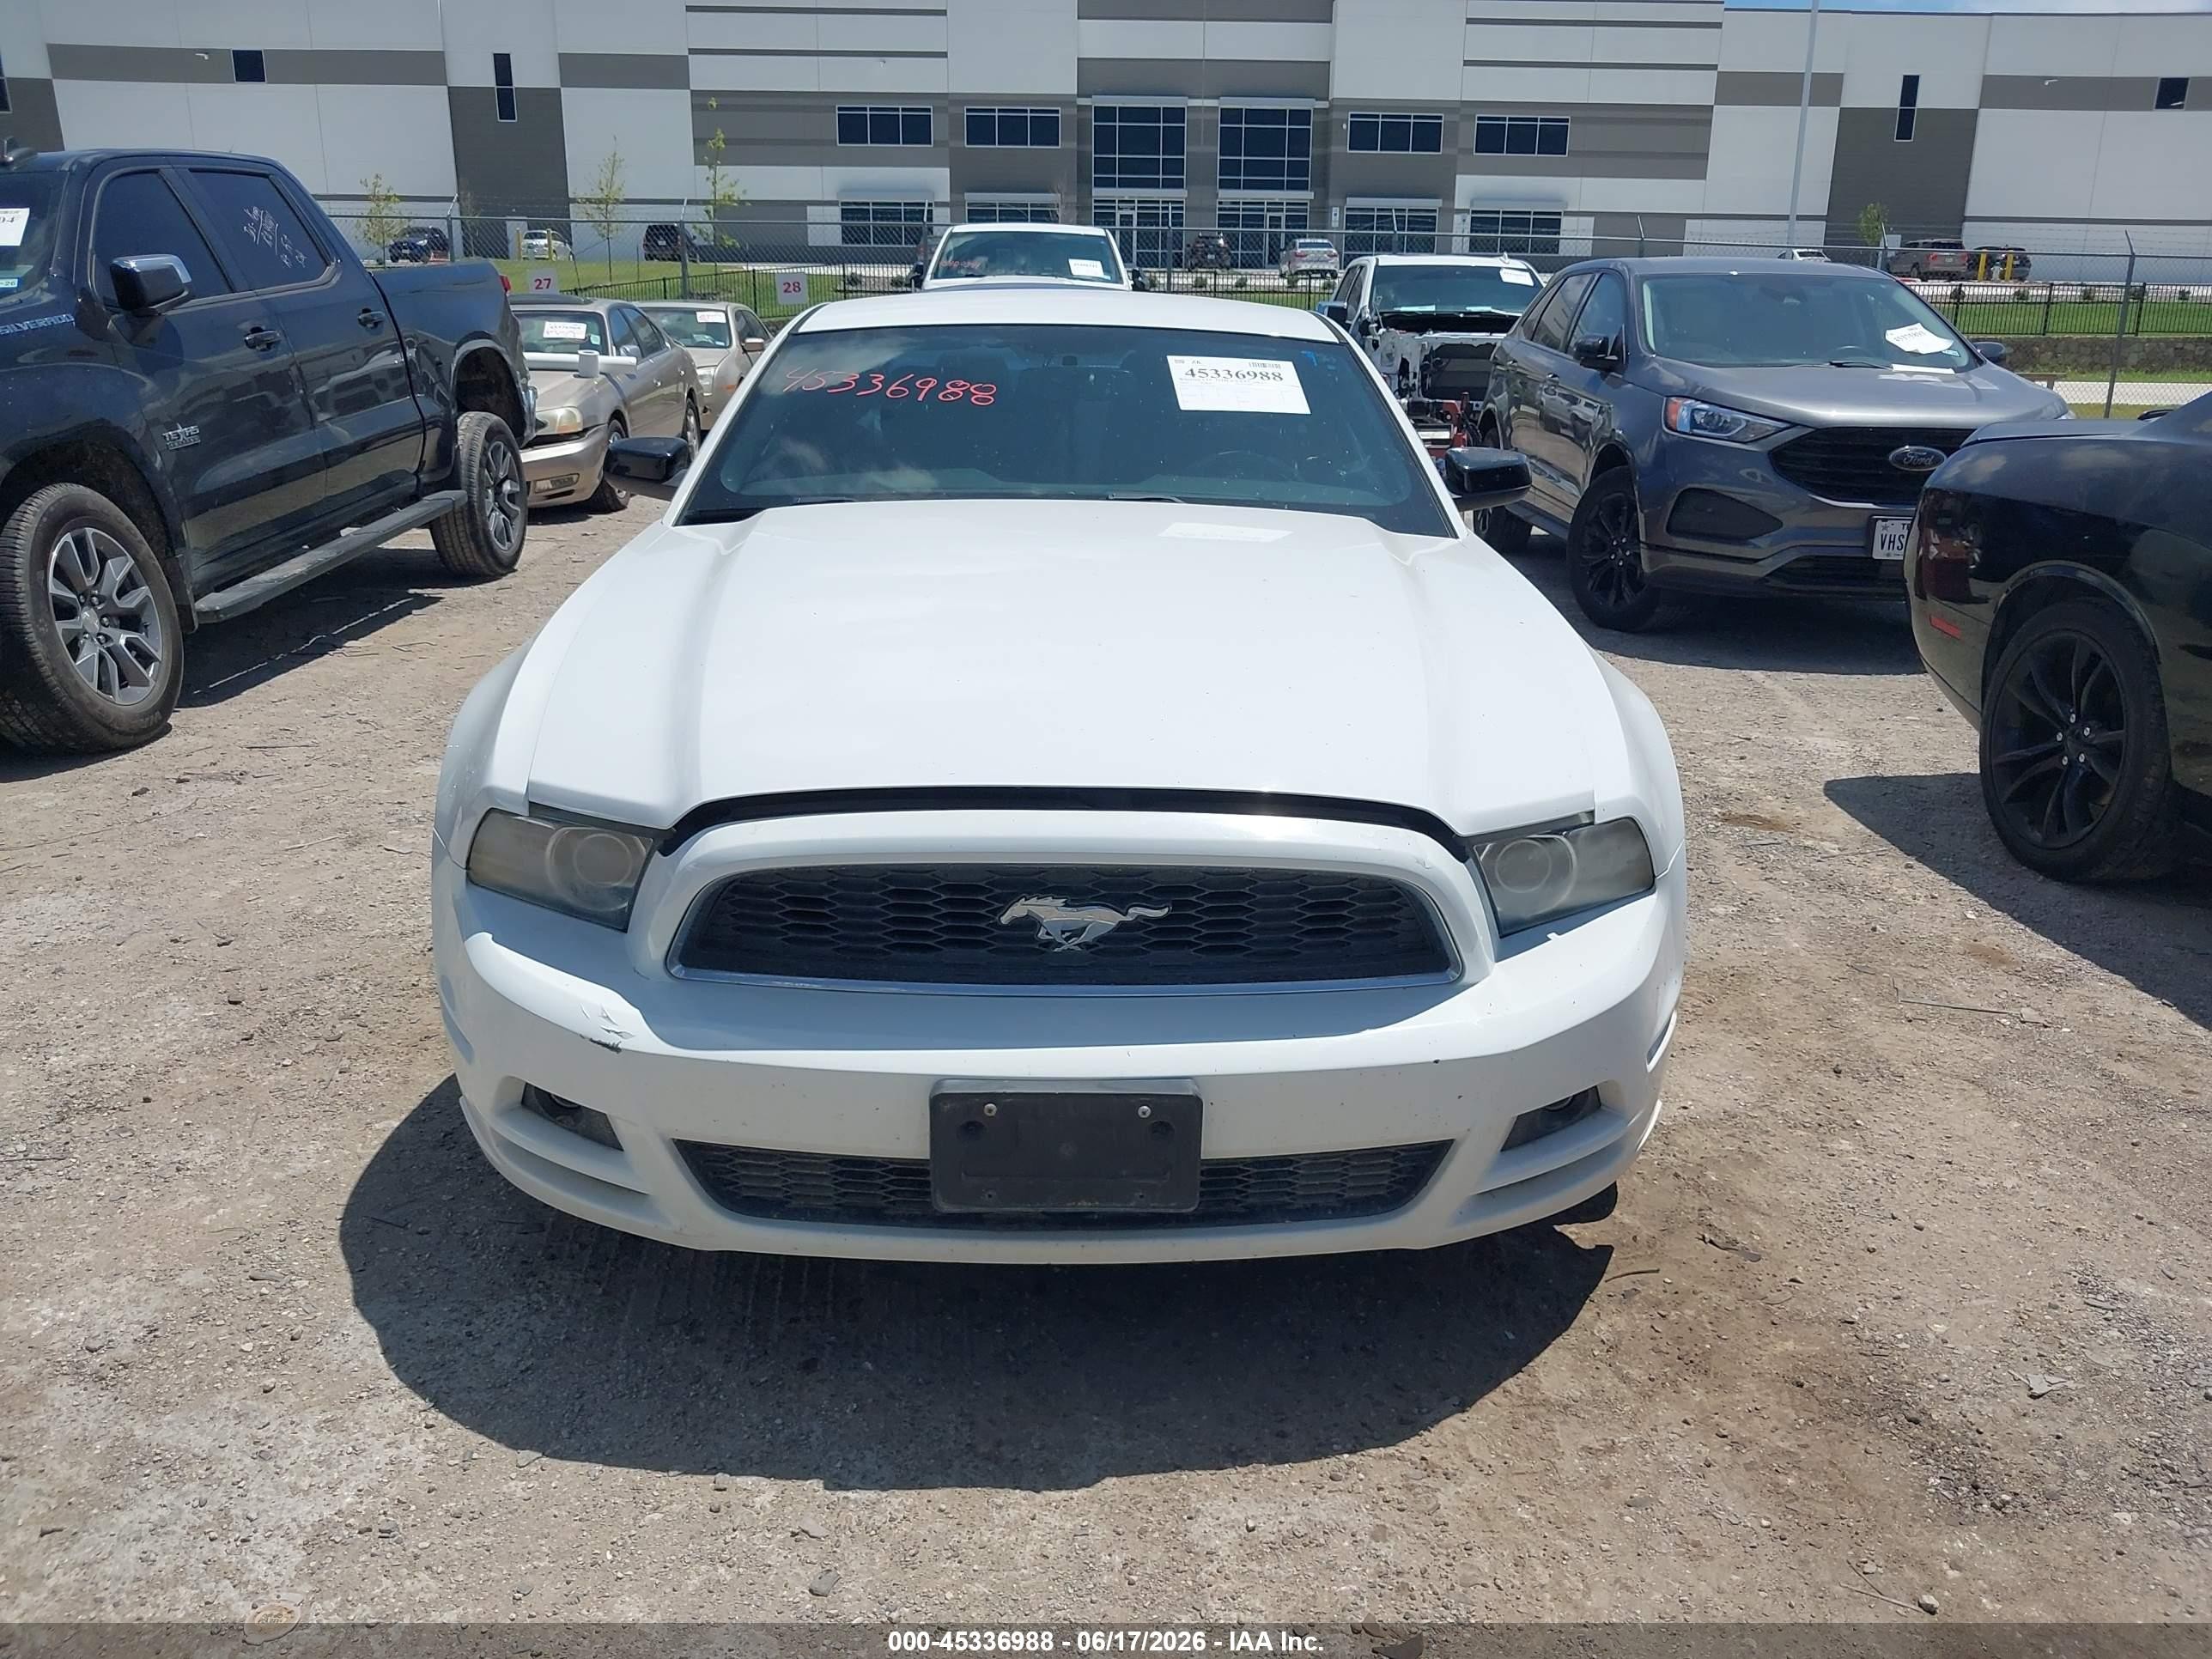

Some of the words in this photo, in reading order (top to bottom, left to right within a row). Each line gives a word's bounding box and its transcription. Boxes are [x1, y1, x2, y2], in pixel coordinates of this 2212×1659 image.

[534, 278, 551, 289] 27
[783, 282, 801, 293] 28
[0, 313, 75, 335] SILVERADO
[1185, 368, 1284, 382] 45336988
[783, 367, 997, 405] 45336988
[1903, 450, 1935, 465] Ford
[1881, 533, 1905, 550] VHS
